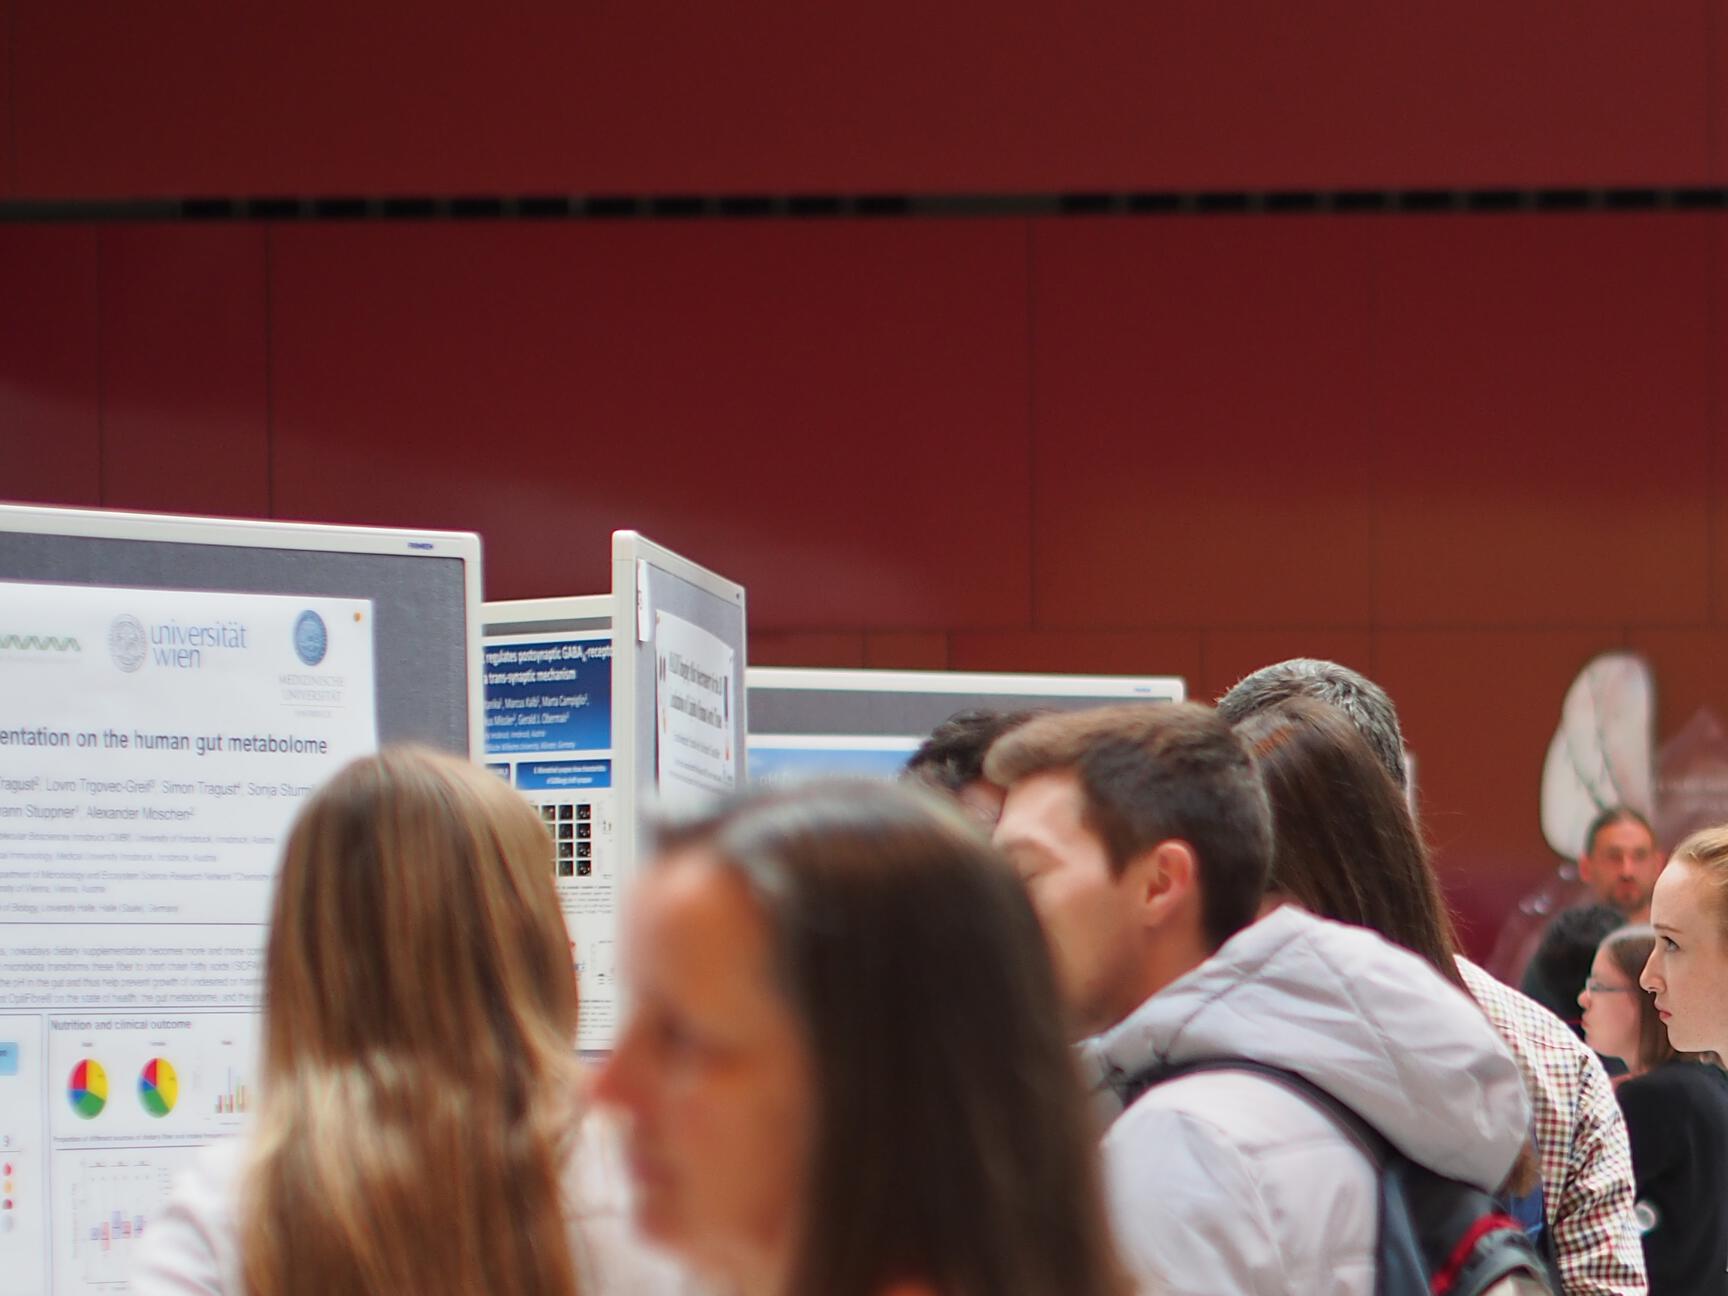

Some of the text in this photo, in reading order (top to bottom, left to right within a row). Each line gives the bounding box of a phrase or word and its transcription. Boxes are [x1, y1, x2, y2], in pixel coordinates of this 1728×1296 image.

[150, 619, 247, 649] universität
[152, 647, 200, 669] wien
[485, 649, 517, 666] regulates
[518, 646, 561, 664] postsynaptic
[537, 667, 577, 682] mechanism
[76, 732, 97, 747] on
[103, 728, 129, 748] the
[134, 730, 190, 750] human
[196, 733, 223, 756] gut
[228, 734, 328, 754] metabolome
[162, 780, 194, 794] Simon
[87, 805, 139, 820] Alexander
[51, 1019, 92, 1032] Nutrition
[95, 1020, 113, 1031] and
[150, 1020, 193, 1031] outcome
